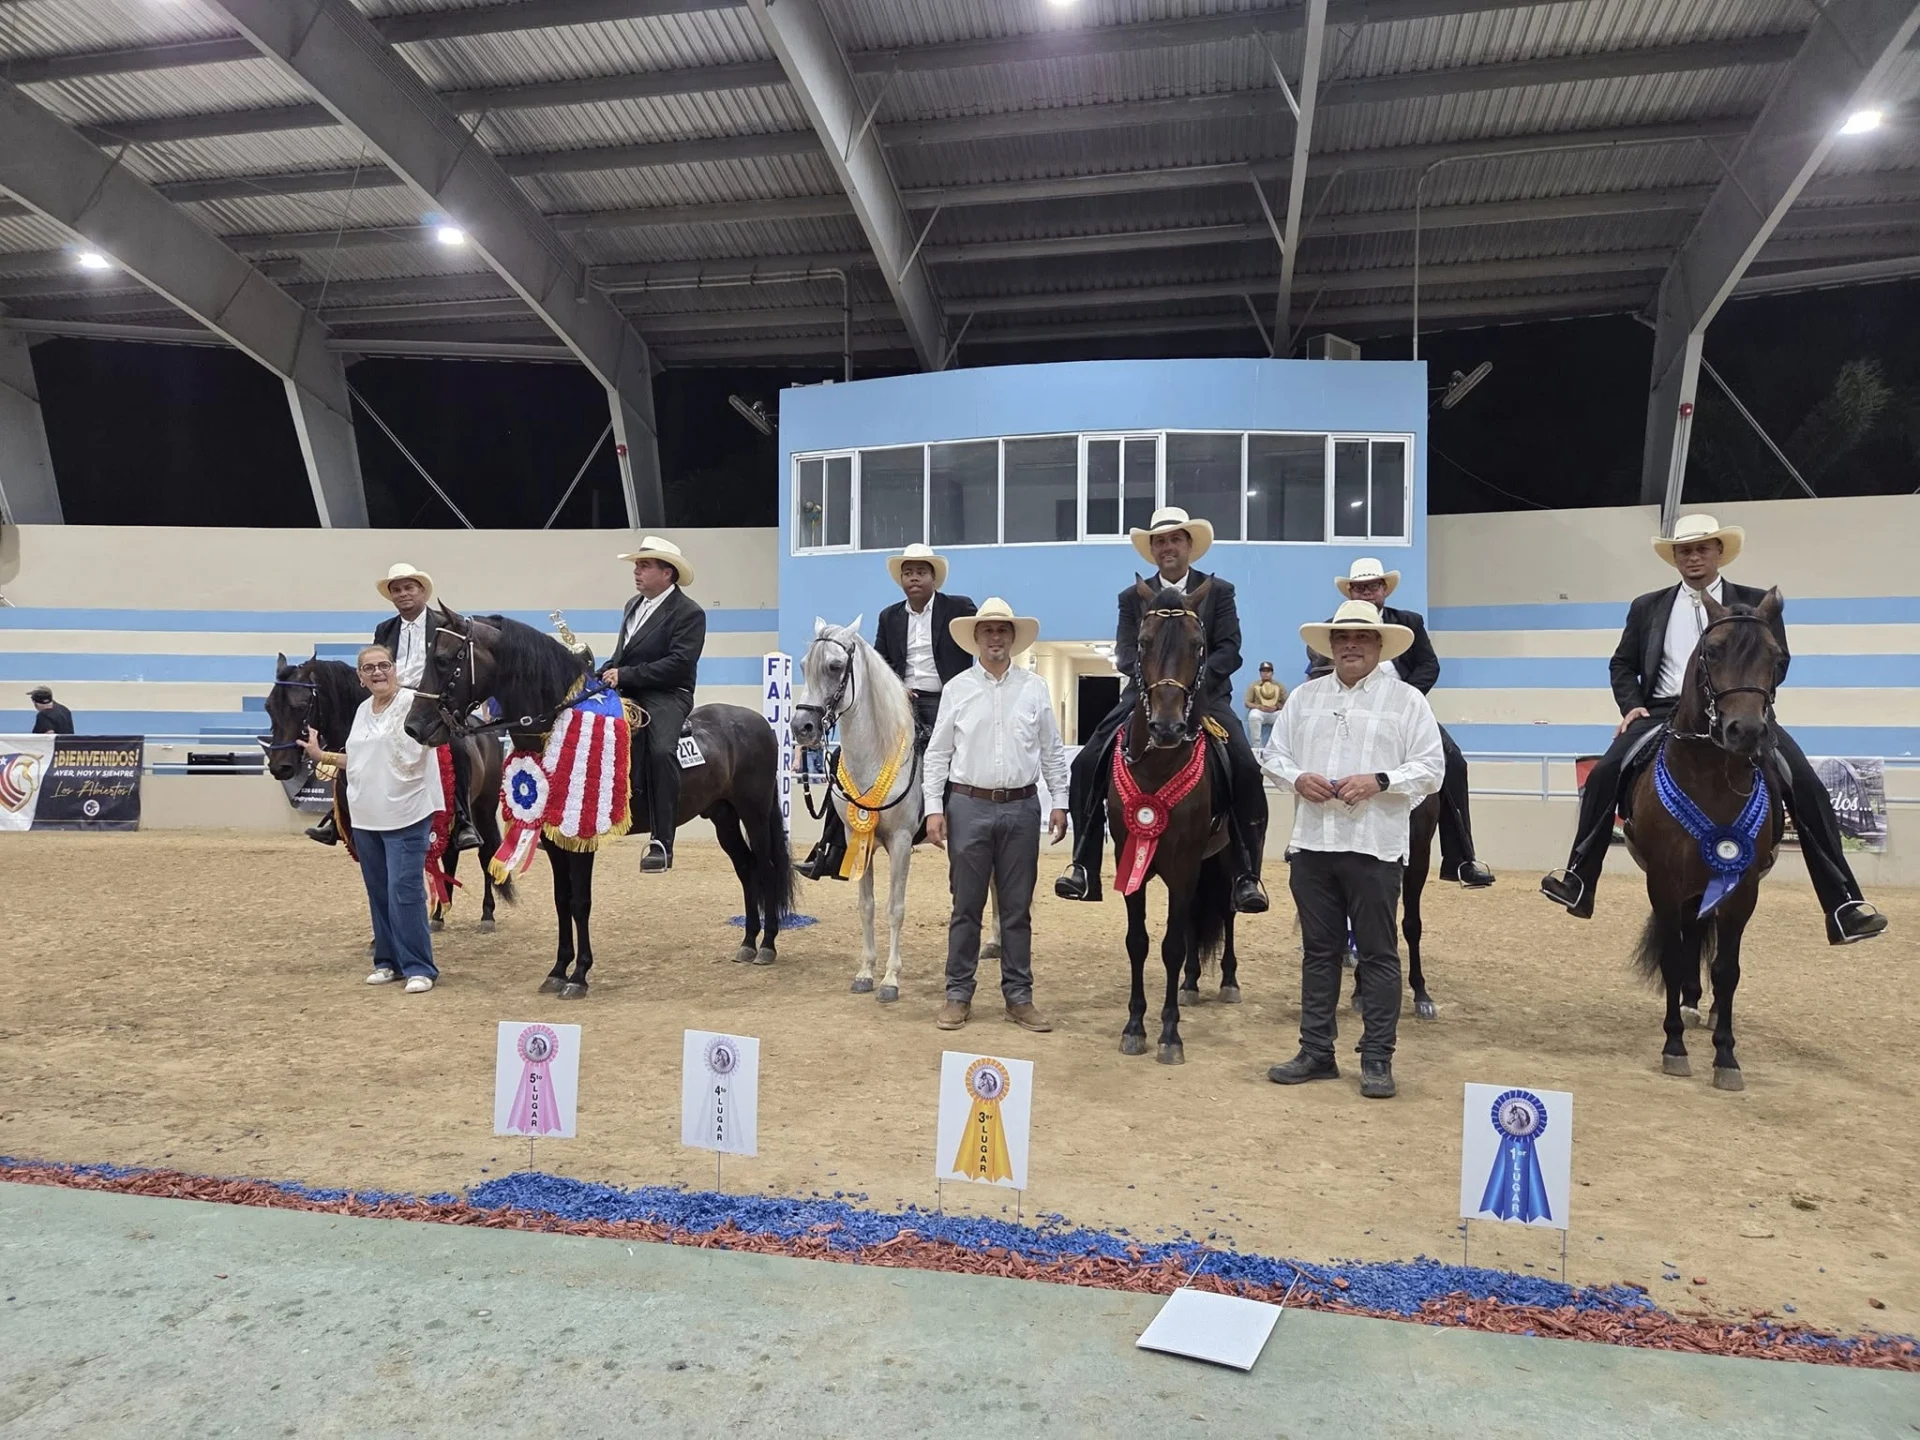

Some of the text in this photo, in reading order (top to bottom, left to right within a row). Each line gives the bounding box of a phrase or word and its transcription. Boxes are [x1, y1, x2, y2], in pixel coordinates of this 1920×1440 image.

[783, 658, 791, 818] FAJARDO
[53, 748, 140, 768] ¡BIENVENIDOS!
[677, 740, 698, 758] 212
[76, 769, 95, 777] HOY
[101, 769, 135, 778] SIEMPRE
[49, 780, 74, 798] Los
[1829, 788, 1873, 812] dos...
[529, 1072, 543, 1084] 5to
[714, 1085, 727, 1097] 4to
[978, 1111, 993, 1173] 3er LUGAR
[1510, 1147, 1527, 1213] 1er LUGAR
